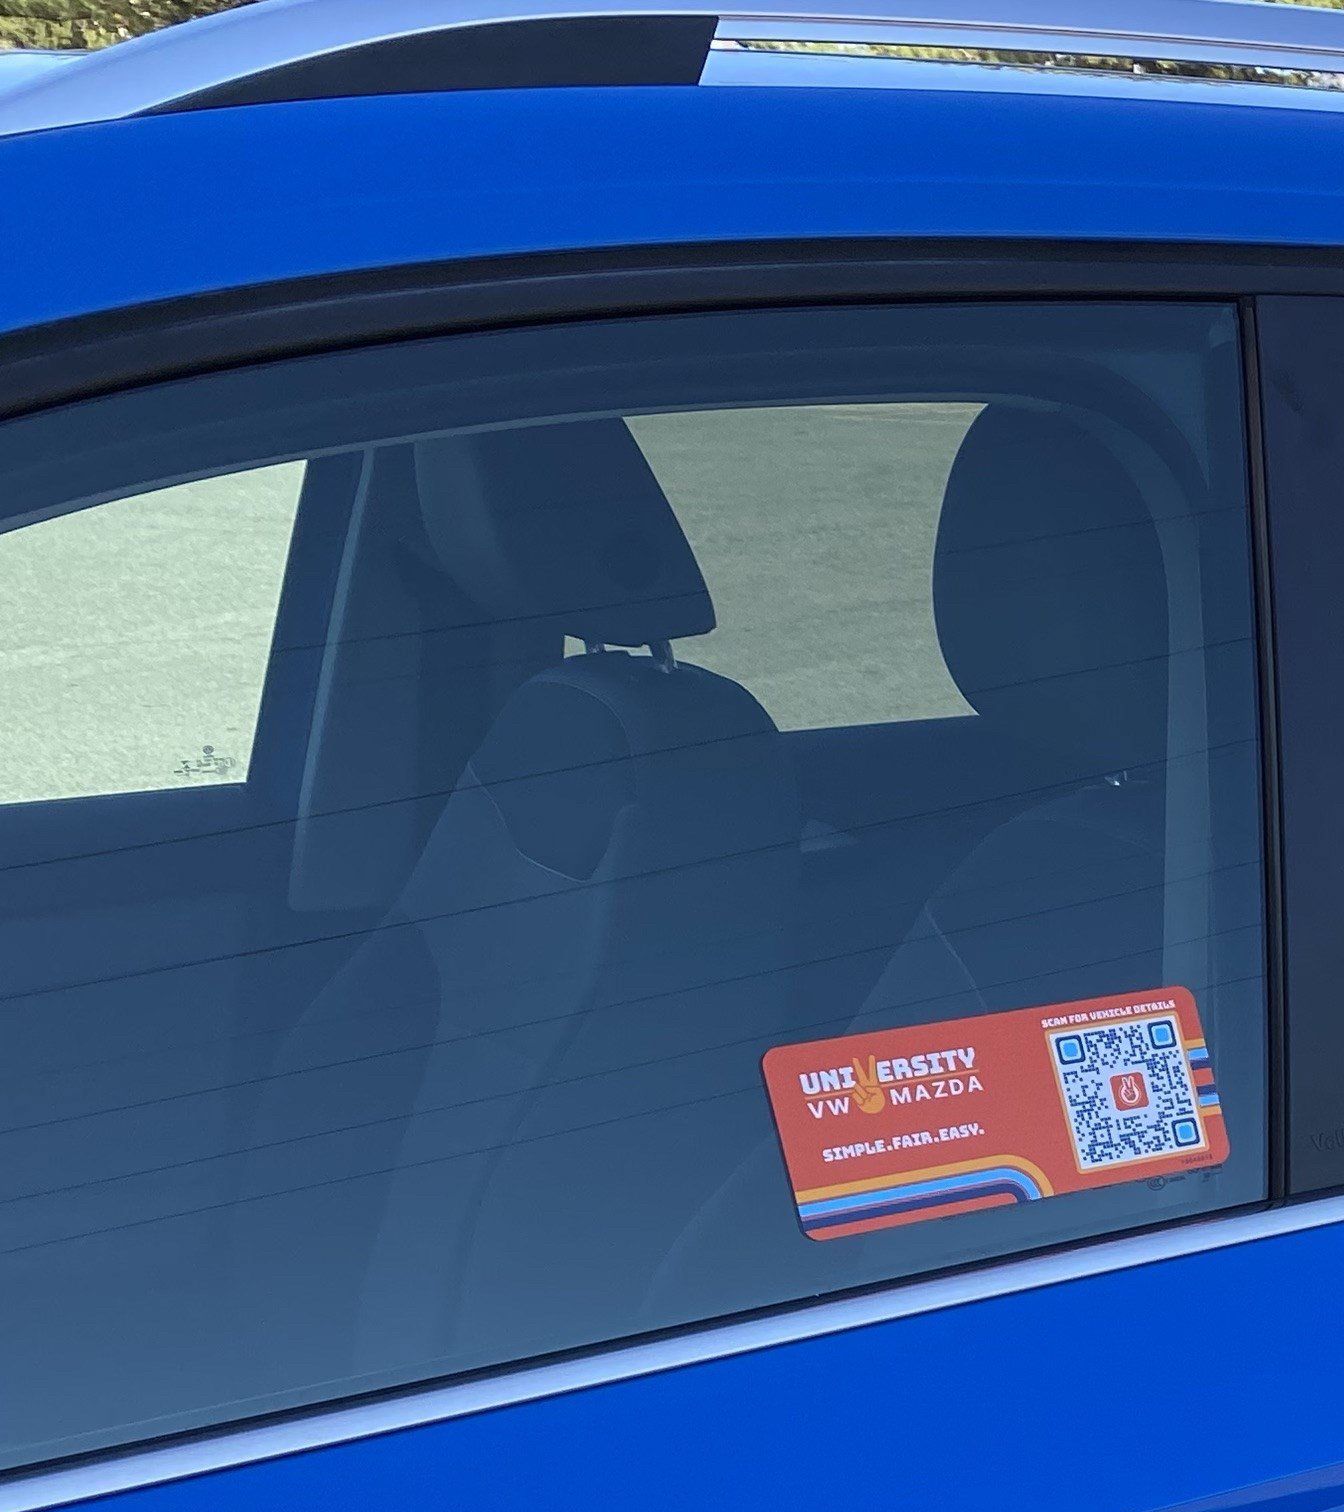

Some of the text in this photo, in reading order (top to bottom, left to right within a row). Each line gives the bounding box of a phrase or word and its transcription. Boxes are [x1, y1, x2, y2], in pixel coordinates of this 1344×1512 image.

[1041, 1000, 1176, 1028] SCAN FOR VEHICLE DETAILS
[799, 1047, 976, 1096] UNIVERSITY
[807, 1075, 984, 1119] VW MAZDA
[822, 1123, 986, 1163] SIMPLE.FAIR.EASY.
